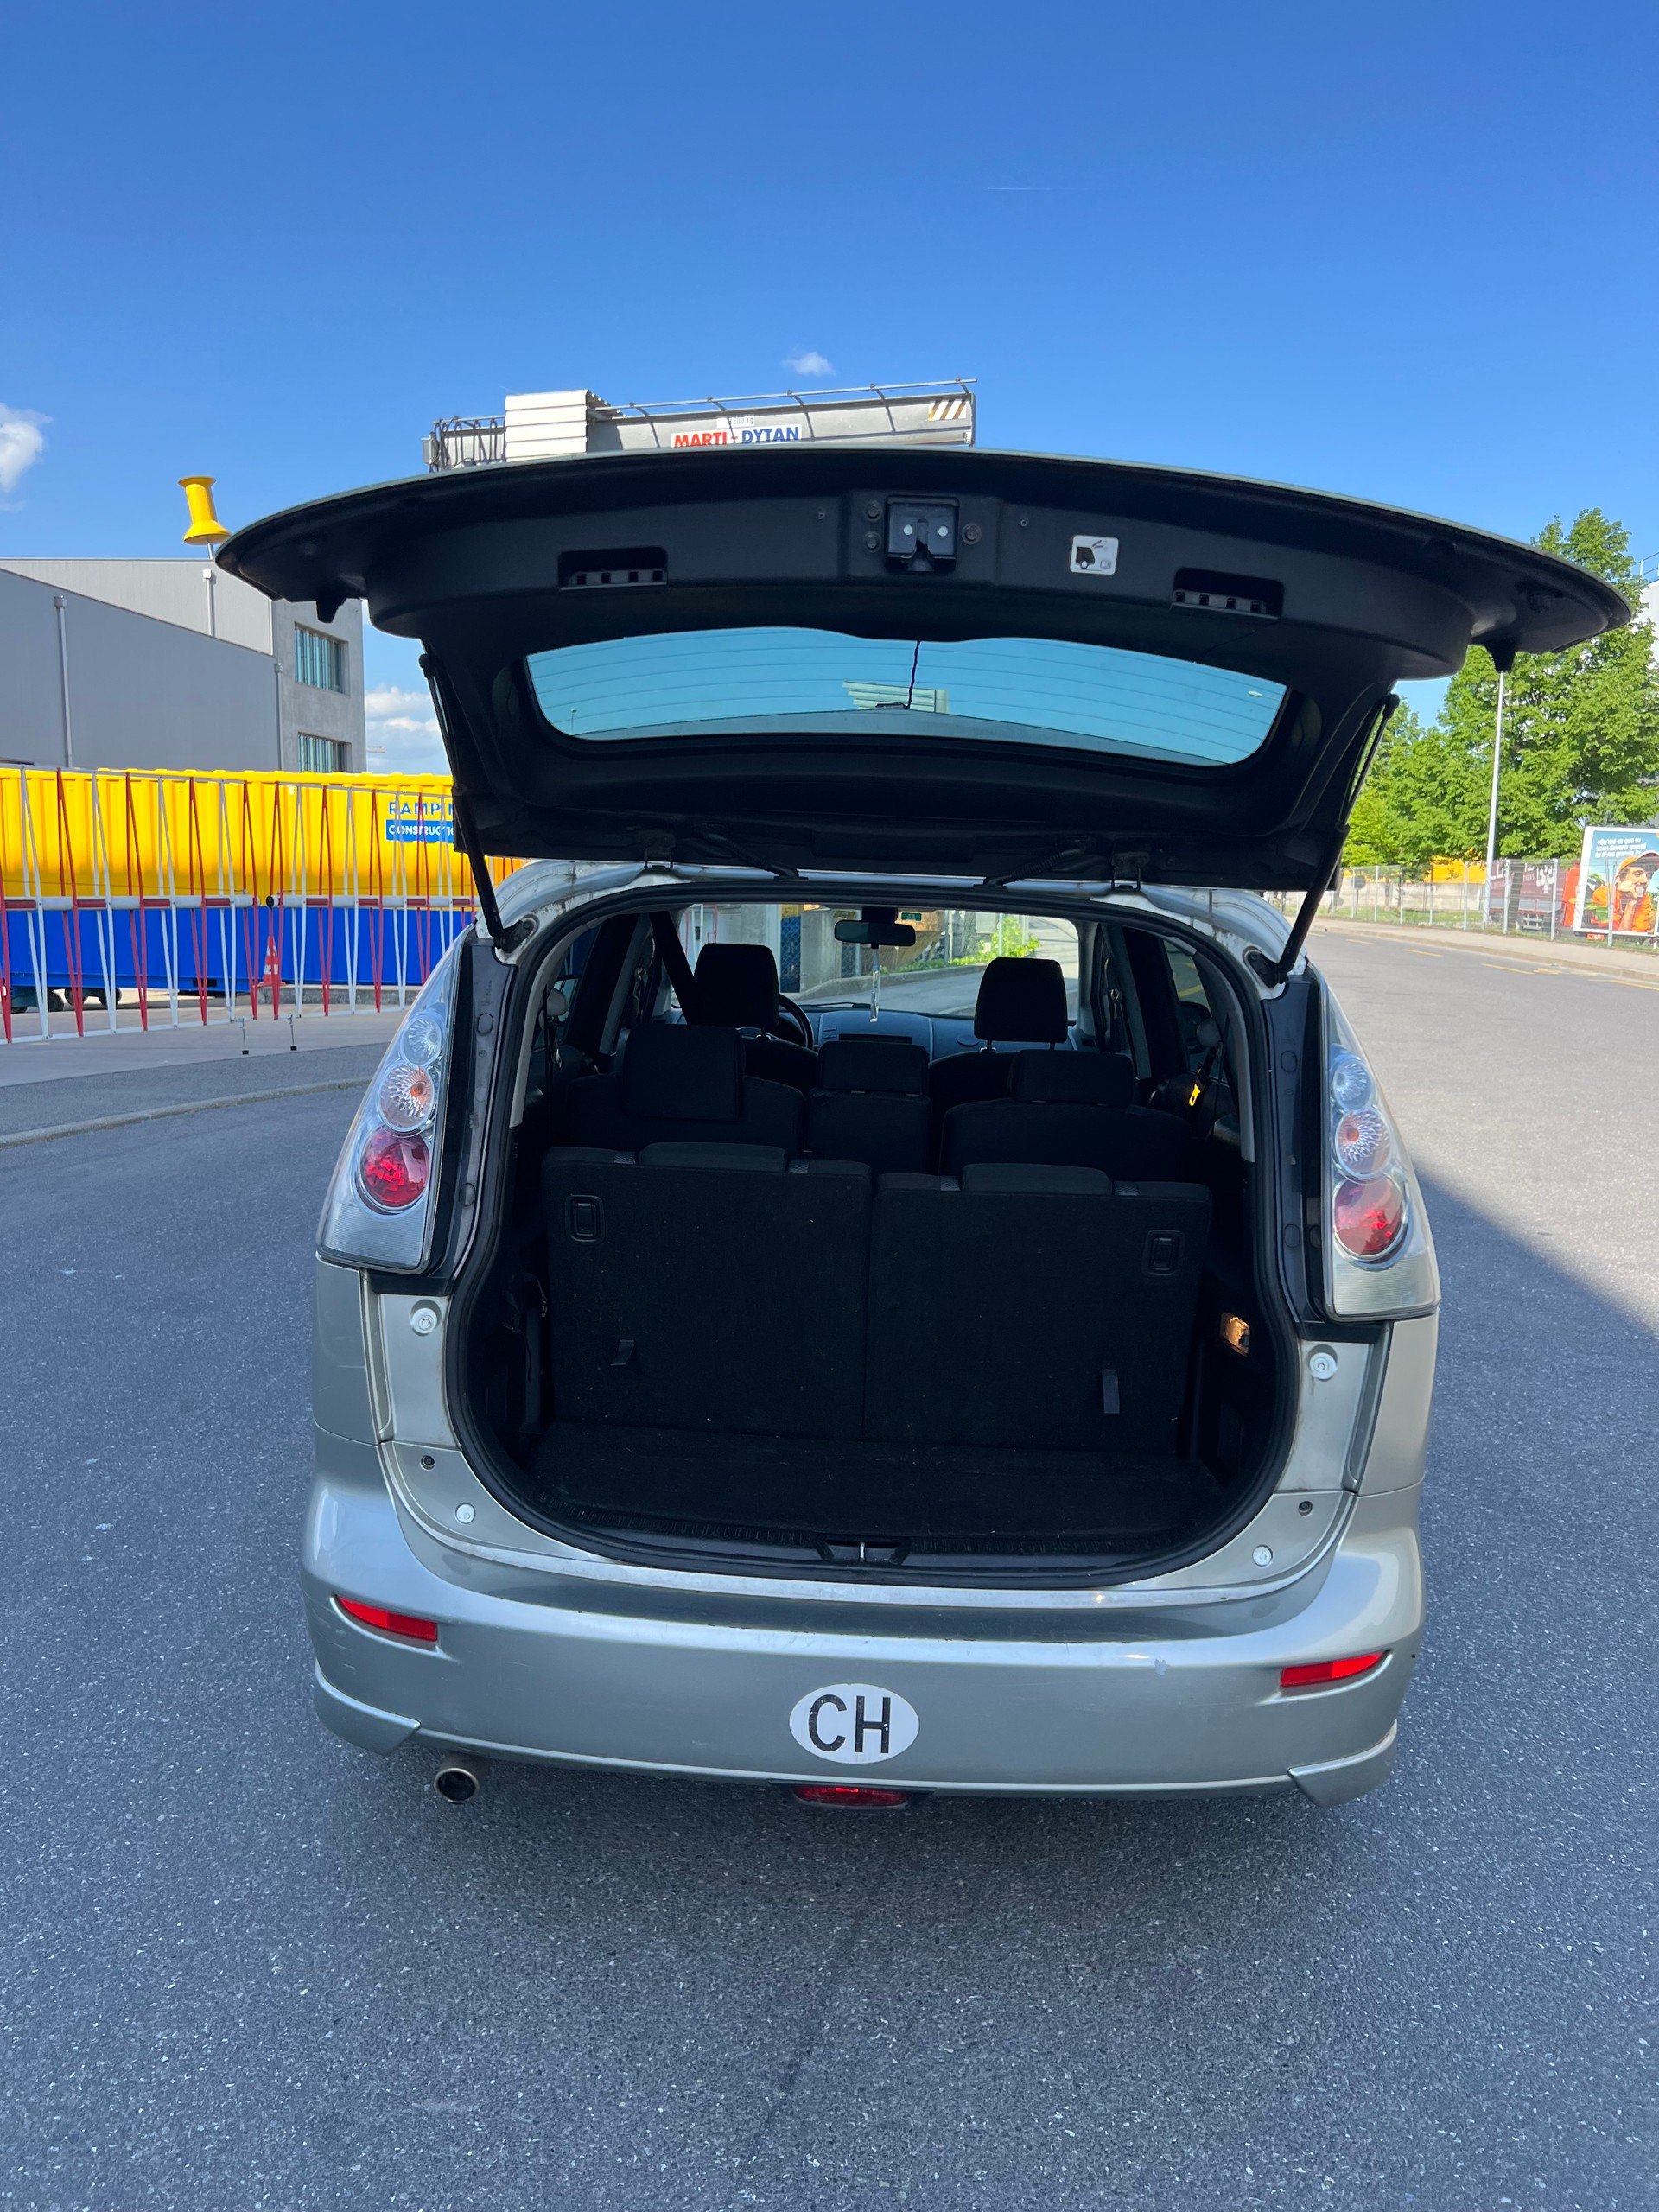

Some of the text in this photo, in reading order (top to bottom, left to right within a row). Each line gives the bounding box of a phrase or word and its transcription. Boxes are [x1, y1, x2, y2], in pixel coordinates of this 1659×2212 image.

[674, 432, 728, 448] MARTI
[741, 426, 799, 444] DYTAN
[808, 1694, 891, 1754] CH
